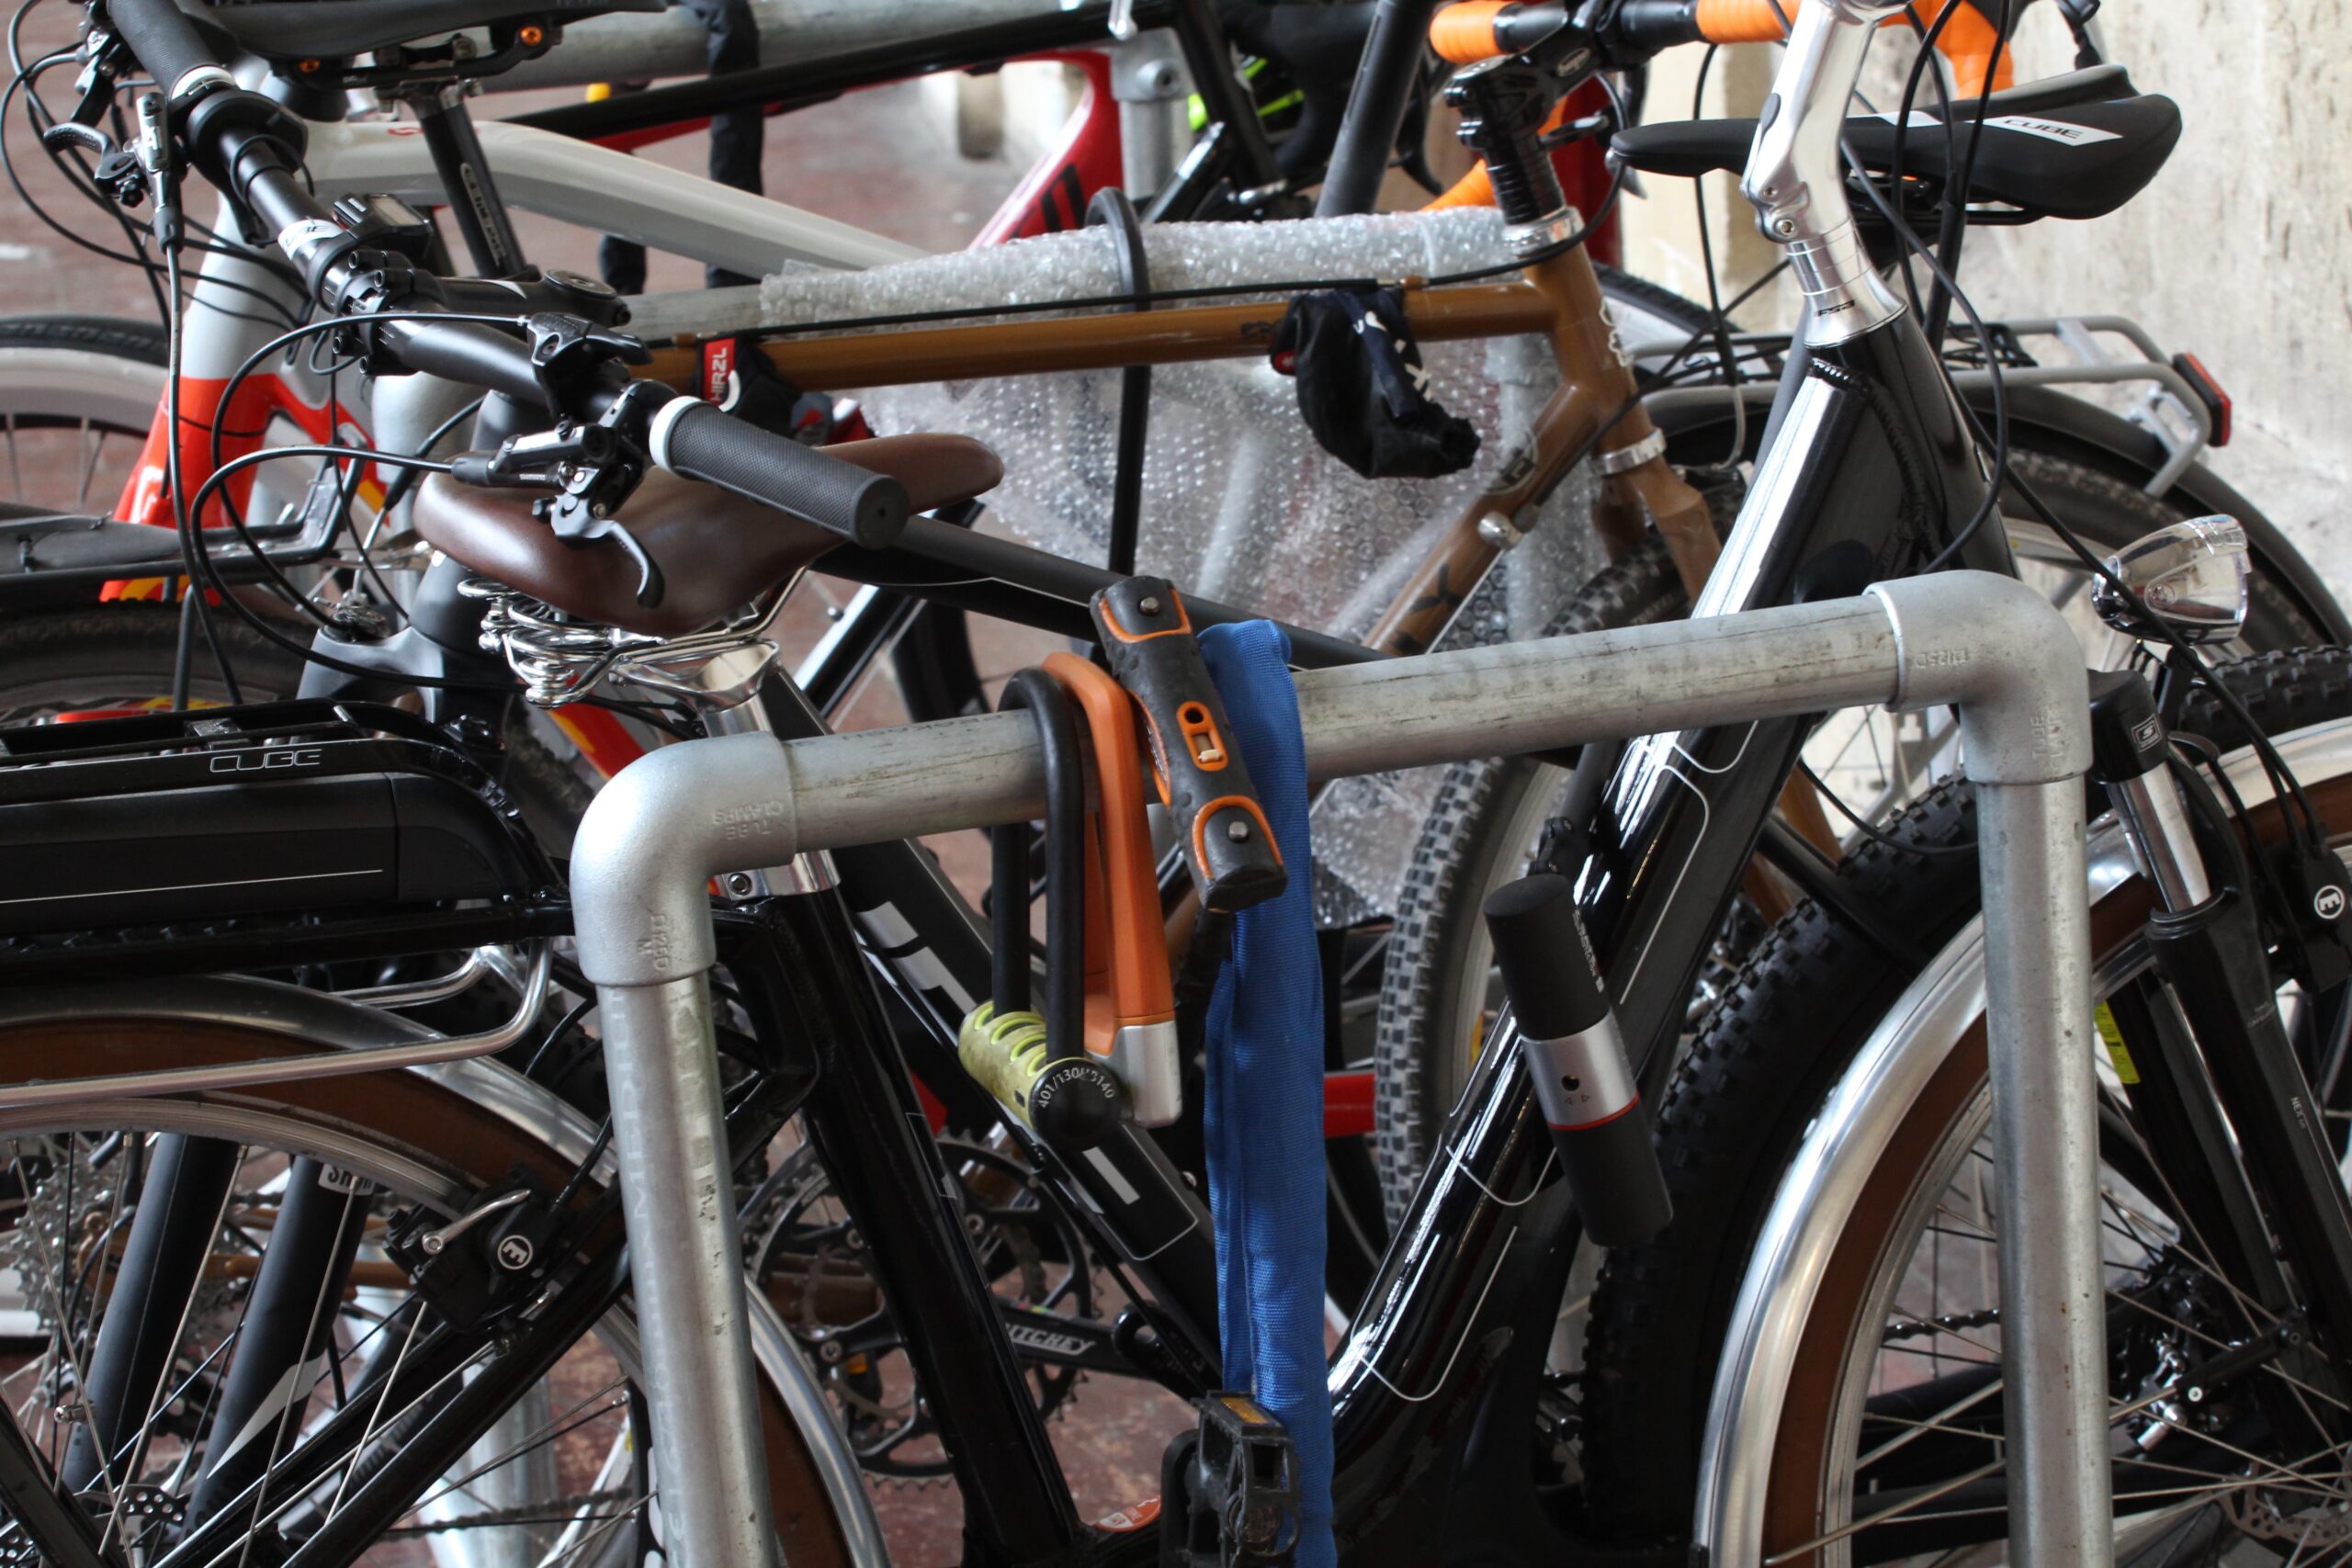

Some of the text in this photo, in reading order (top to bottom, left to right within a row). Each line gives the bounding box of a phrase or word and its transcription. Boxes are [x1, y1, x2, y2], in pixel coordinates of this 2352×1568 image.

[2004, 118, 2084, 140] CUBE
[710, 346, 729, 401] HIRZL
[209, 748, 322, 773] CUBE
[1005, 1323, 1097, 1356] ITCHEY
